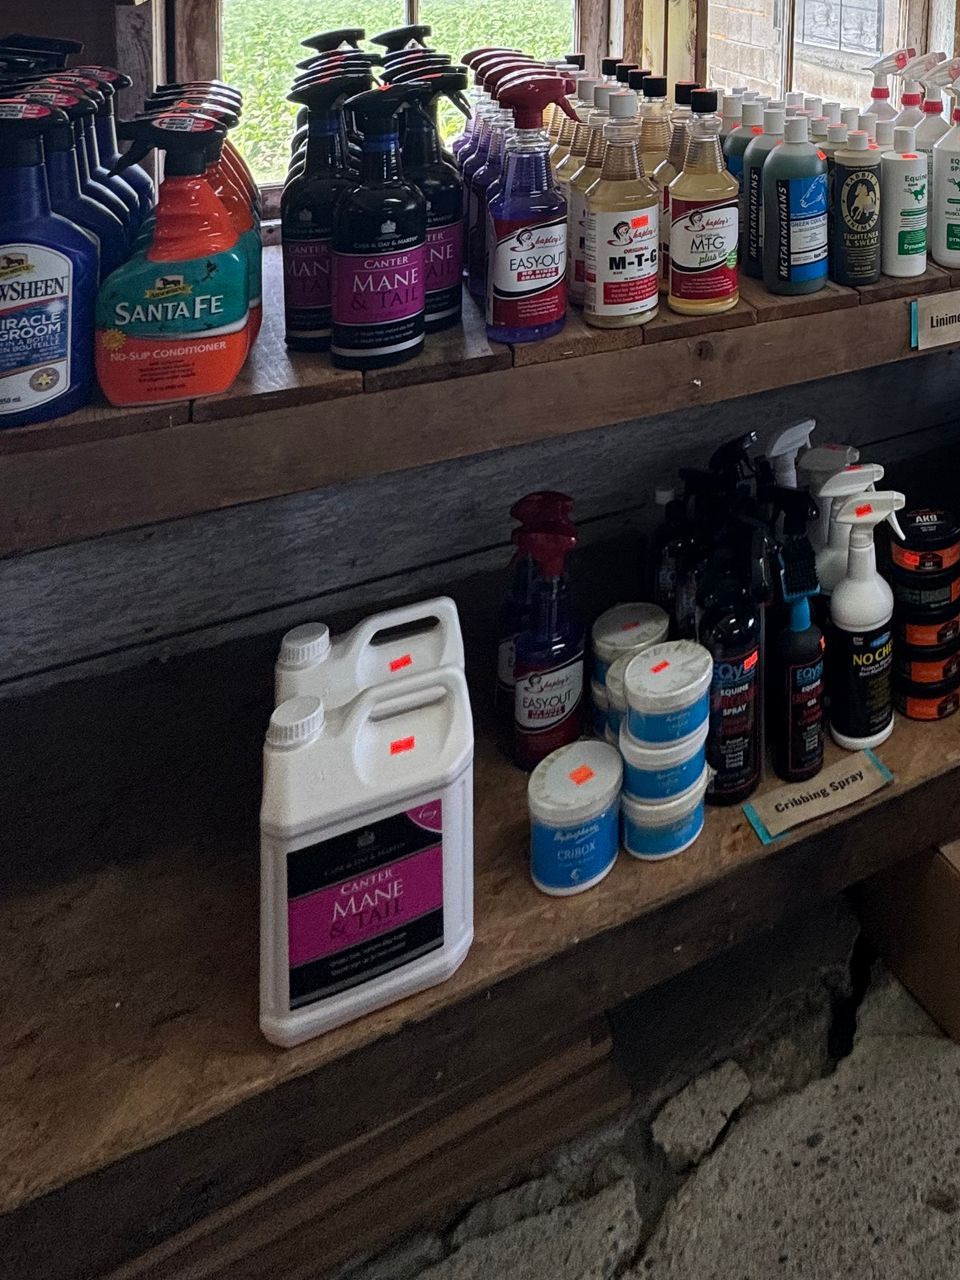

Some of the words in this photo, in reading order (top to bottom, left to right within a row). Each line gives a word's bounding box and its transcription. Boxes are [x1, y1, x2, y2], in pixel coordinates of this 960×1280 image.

[855, 238, 878, 247] SWEAT
[286, 259, 330, 277] MAN
[364, 255, 409, 270] CANTER
[510, 251, 565, 271] EASY-OUT
[609, 249, 657, 271] M-T-G
[352, 267, 419, 293] MANE
[351, 293, 367, 312] &
[374, 286, 418, 310] TAIL
[114, 301, 190, 326] SANTA
[193, 294, 224, 319] FE
[0, 312, 61, 330] IRACLE
[0, 324, 61, 341] GROOM
[110, 350, 150, 361] NO-SLIP
[153, 341, 227, 359] CONDITIONER
[853, 653, 874, 666] NO
[875, 640, 893, 661] CHE
[720, 683, 749, 697] EQUINE
[722, 704, 747, 717] SPRAY
[774, 787, 830, 813] Cribbing
[829, 770, 865, 795] Spray
[557, 840, 597, 860] CRIBOX
[340, 869, 394, 896] CANTER
[332, 878, 404, 922] MANE
[328, 921, 347, 939] &
[354, 900, 404, 930] TAIL
